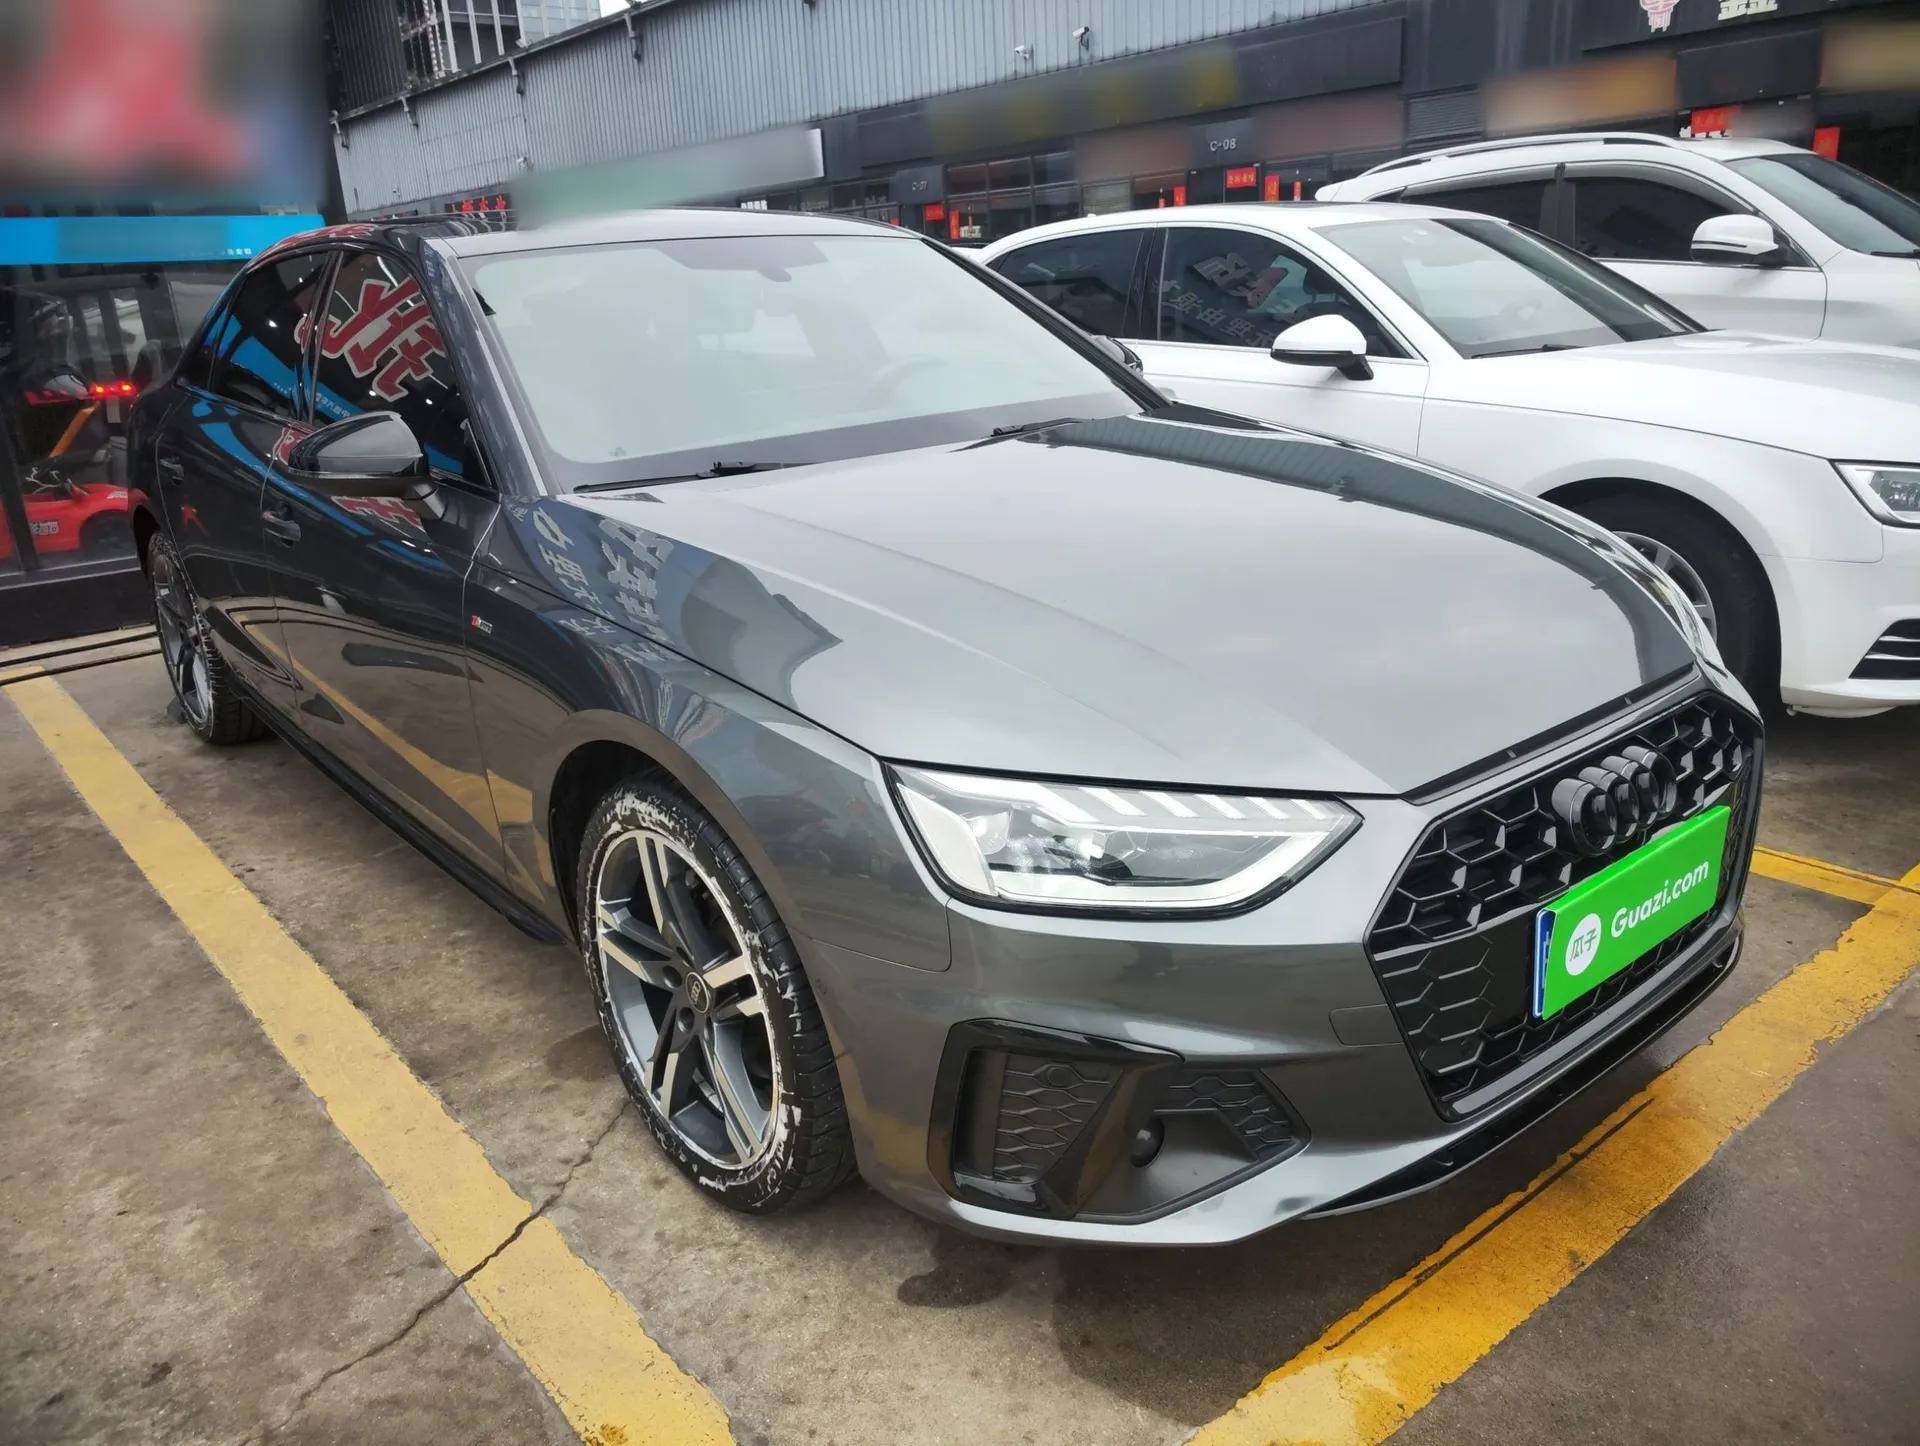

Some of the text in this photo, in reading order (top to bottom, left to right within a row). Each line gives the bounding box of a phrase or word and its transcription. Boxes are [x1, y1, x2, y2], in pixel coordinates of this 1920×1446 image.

[1210, 138, 1237, 151] C-08
[1610, 860, 1709, 939] Guazi.com
[1569, 929, 1598, 962] 瓜子
